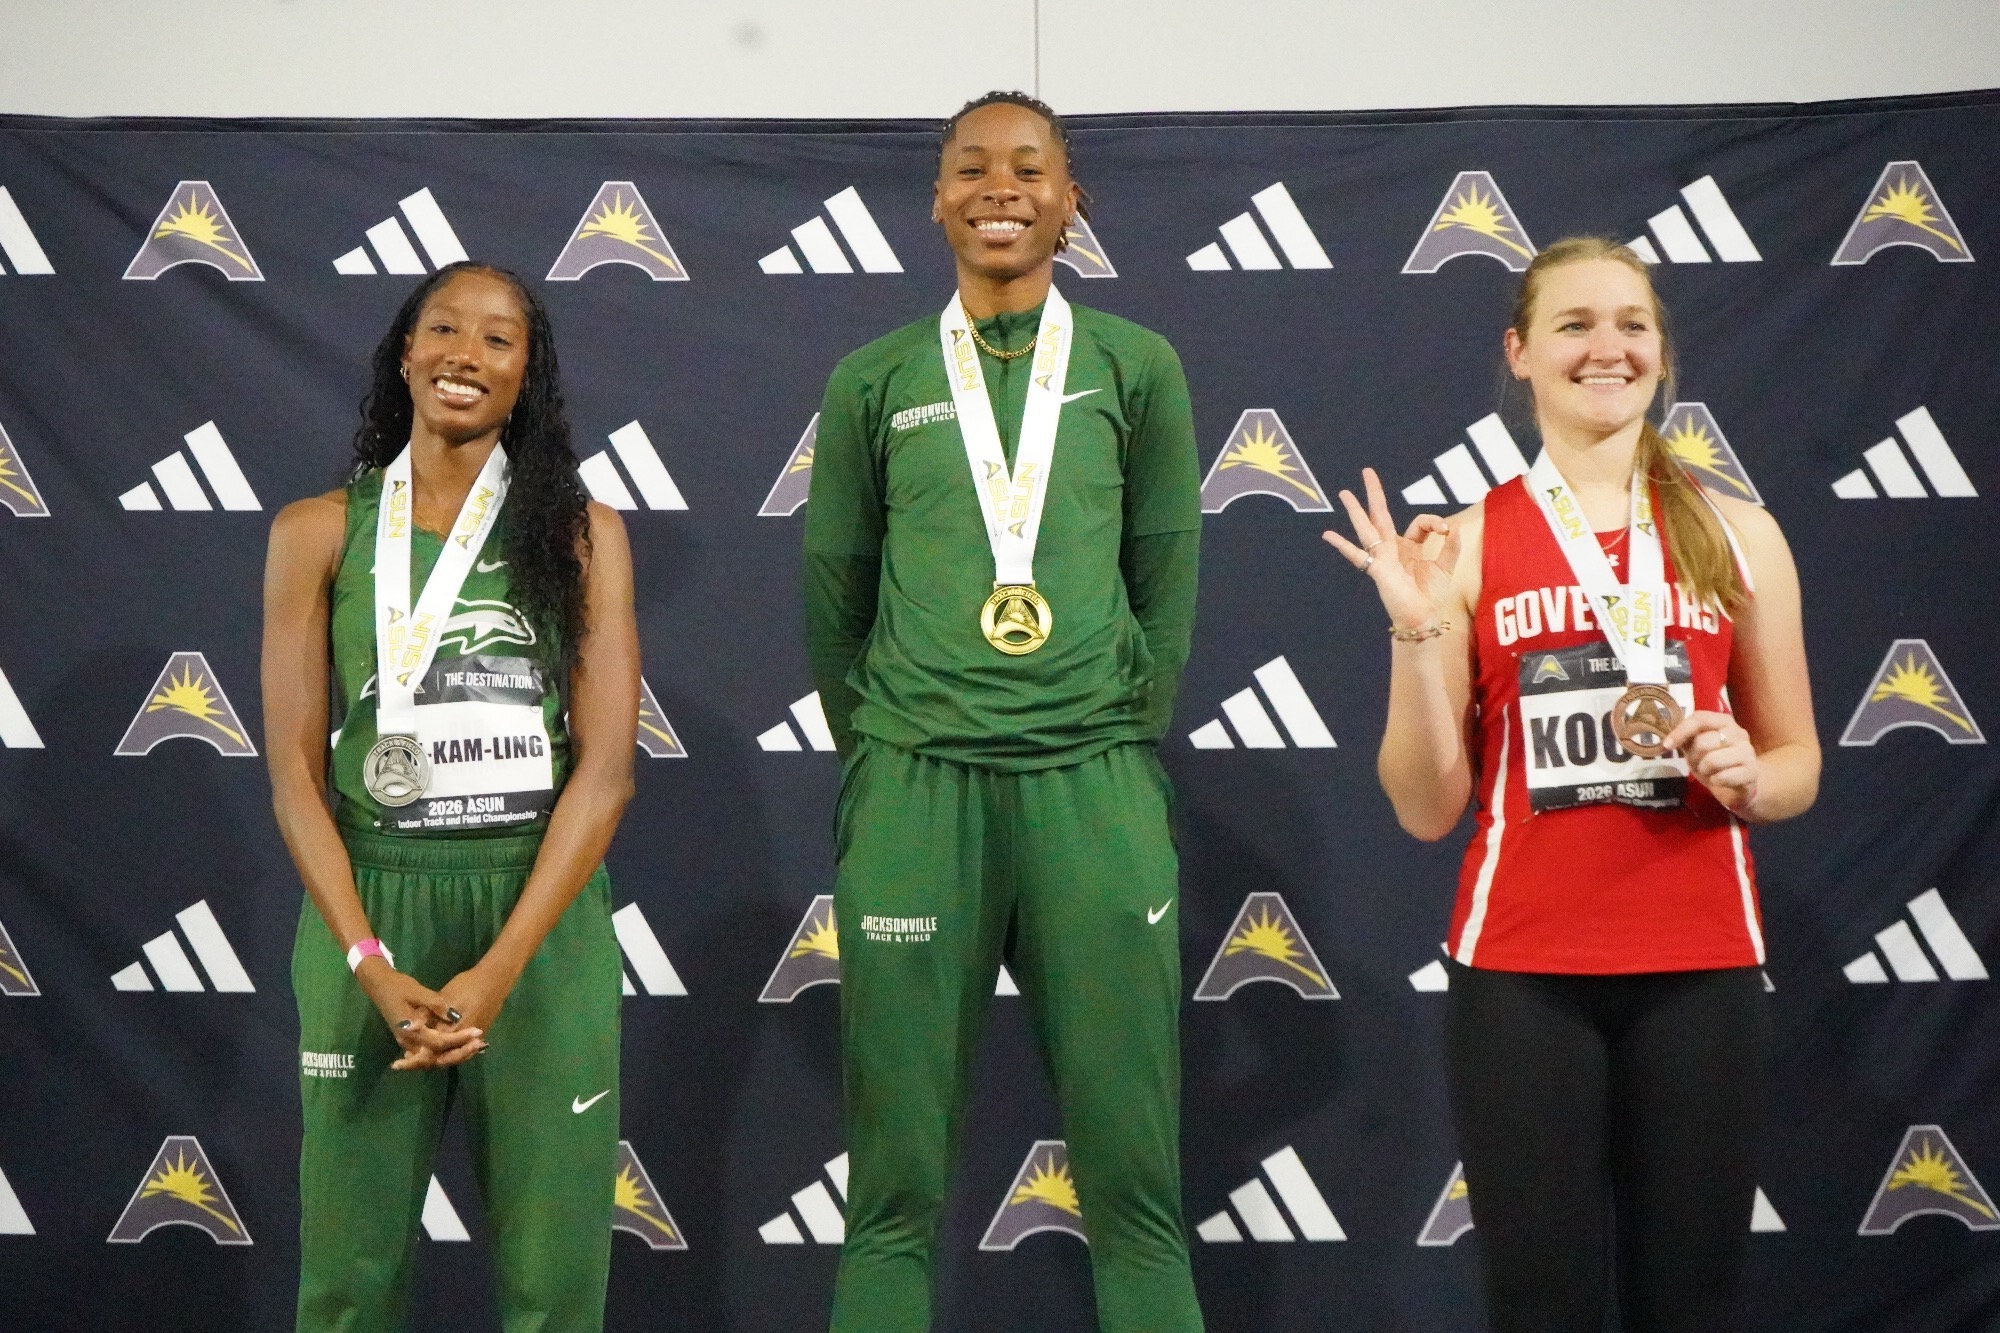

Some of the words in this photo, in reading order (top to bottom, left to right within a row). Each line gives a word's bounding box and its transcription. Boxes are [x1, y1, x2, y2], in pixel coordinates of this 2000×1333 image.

[891, 401, 956, 428] JACKSONVILL
[897, 419, 920, 432] TRACK
[931, 412, 955, 423] FIELD
[983, 459, 1009, 521] ASU
[388, 606, 405, 668] ASU
[1588, 658, 1610, 672] THE
[445, 672, 464, 687] THE
[466, 672, 535, 689] DESTINATION.
[421, 735, 544, 765] -KAM-LING
[1577, 785, 1613, 801] 2026
[1617, 782, 1654, 798] ASUN
[428, 801, 463, 816] 2026
[467, 796, 504, 814] ASUN
[398, 818, 422, 829] Indoor
[423, 816, 444, 827] Track
[446, 815, 460, 825] and
[462, 813, 481, 824] Field
[483, 810, 537, 823] Championship
[861, 915, 937, 933] JACKSONVILLE
[866, 932, 892, 941] TRACK
[905, 933, 931, 942] FIELD
[325, 1069, 348, 1078] FIELD
